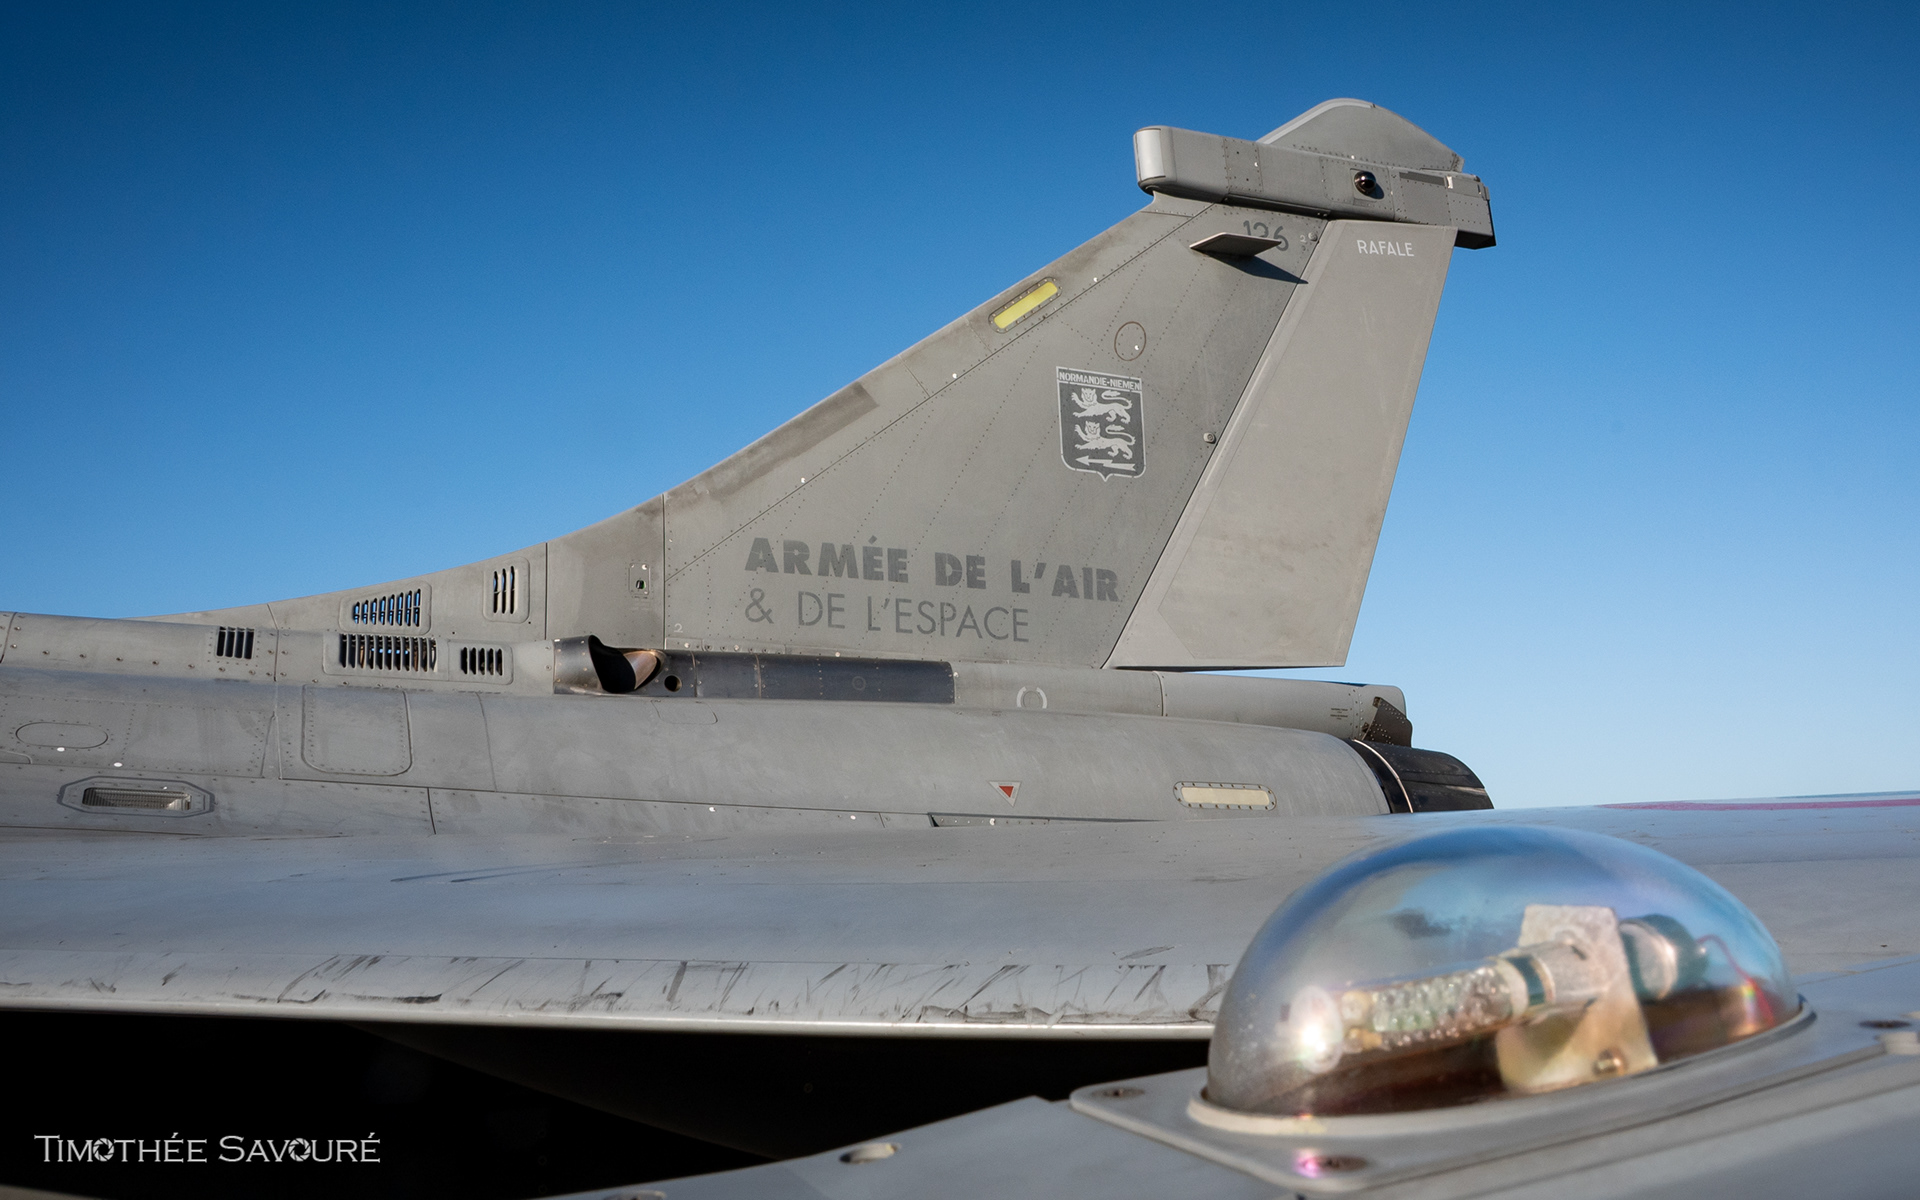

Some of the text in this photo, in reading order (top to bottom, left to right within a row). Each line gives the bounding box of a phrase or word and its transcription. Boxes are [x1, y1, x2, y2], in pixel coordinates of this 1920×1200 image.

[1356, 239, 1415, 257] RAFALE
[1059, 371, 1141, 391] NORMANDIE-NIEMEN
[744, 535, 1119, 603] ARMÉE DE L'AIR
[744, 587, 1030, 643] & DE L'ESPACE
[673, 622, 684, 634] 2
